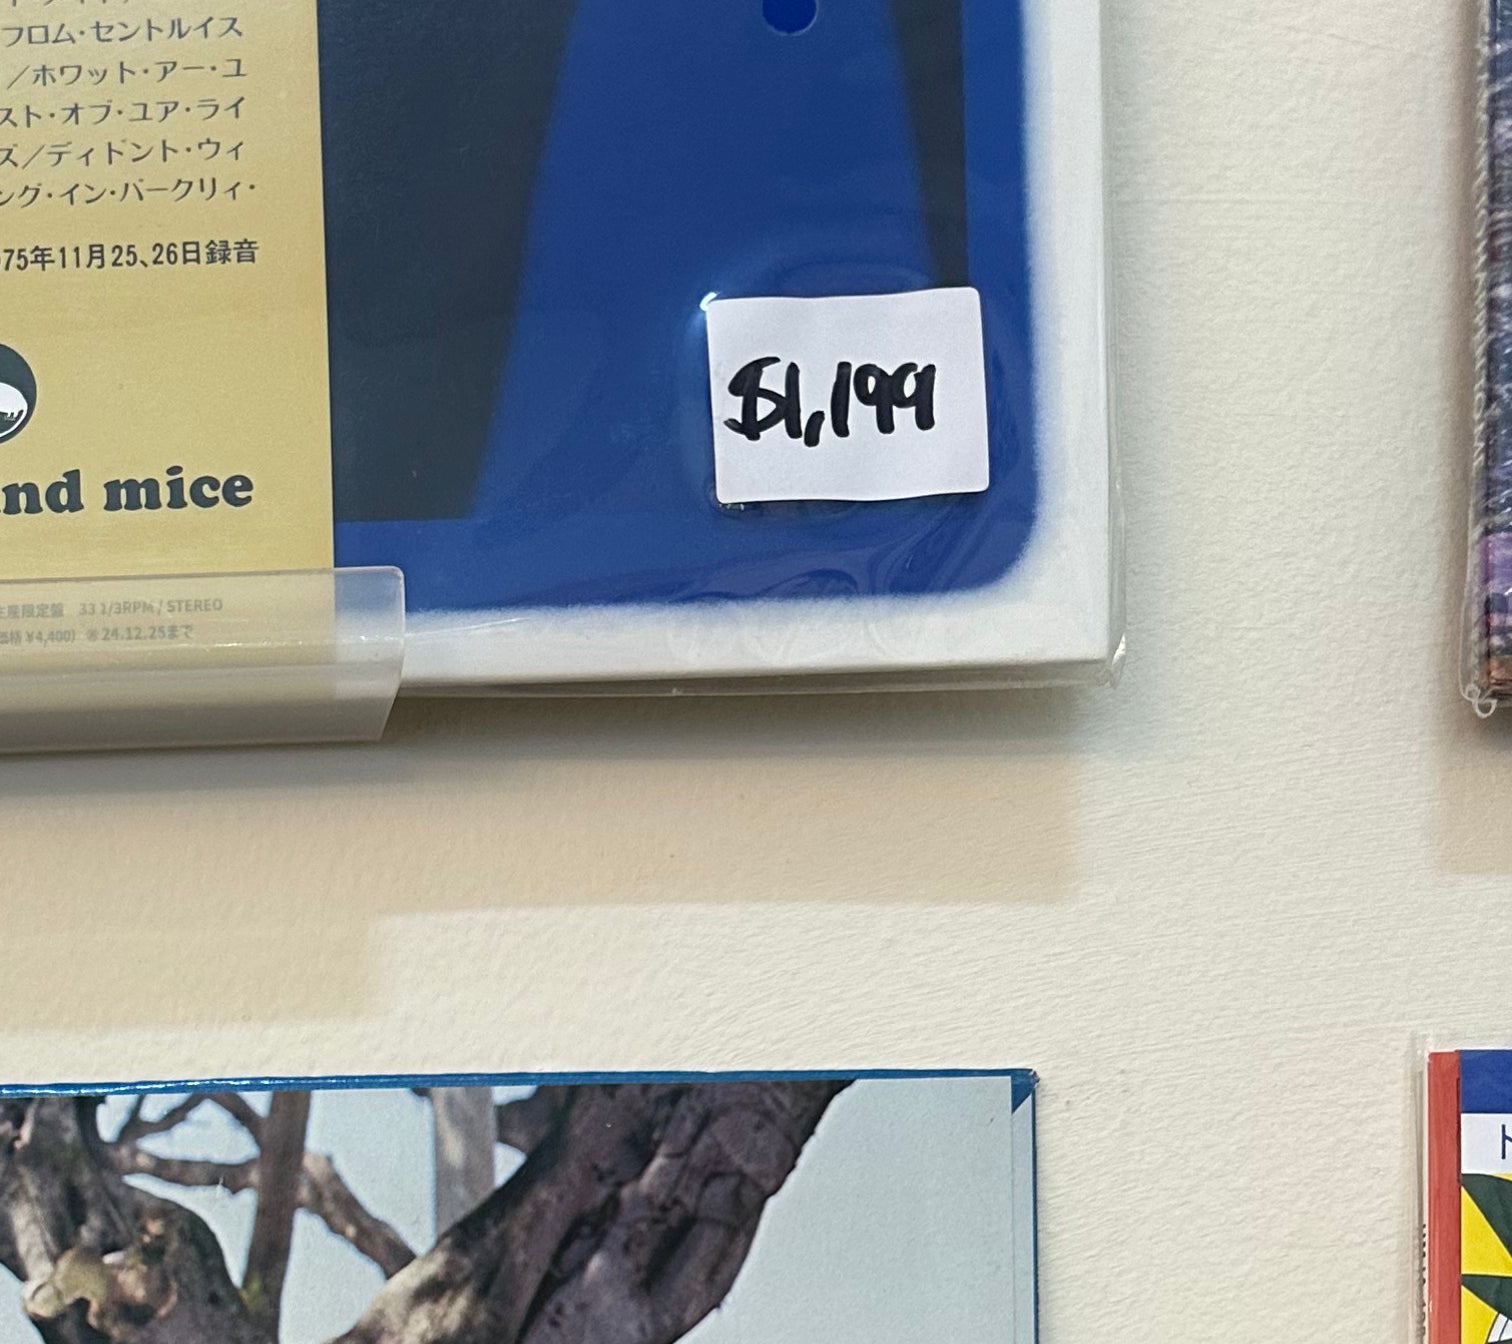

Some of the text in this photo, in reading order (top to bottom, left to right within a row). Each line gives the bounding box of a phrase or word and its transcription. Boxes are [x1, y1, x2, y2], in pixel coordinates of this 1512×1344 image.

[723, 355, 937, 448] $1,199
[102, 466, 254, 511] mice
[166, 598, 224, 613] STEREO
